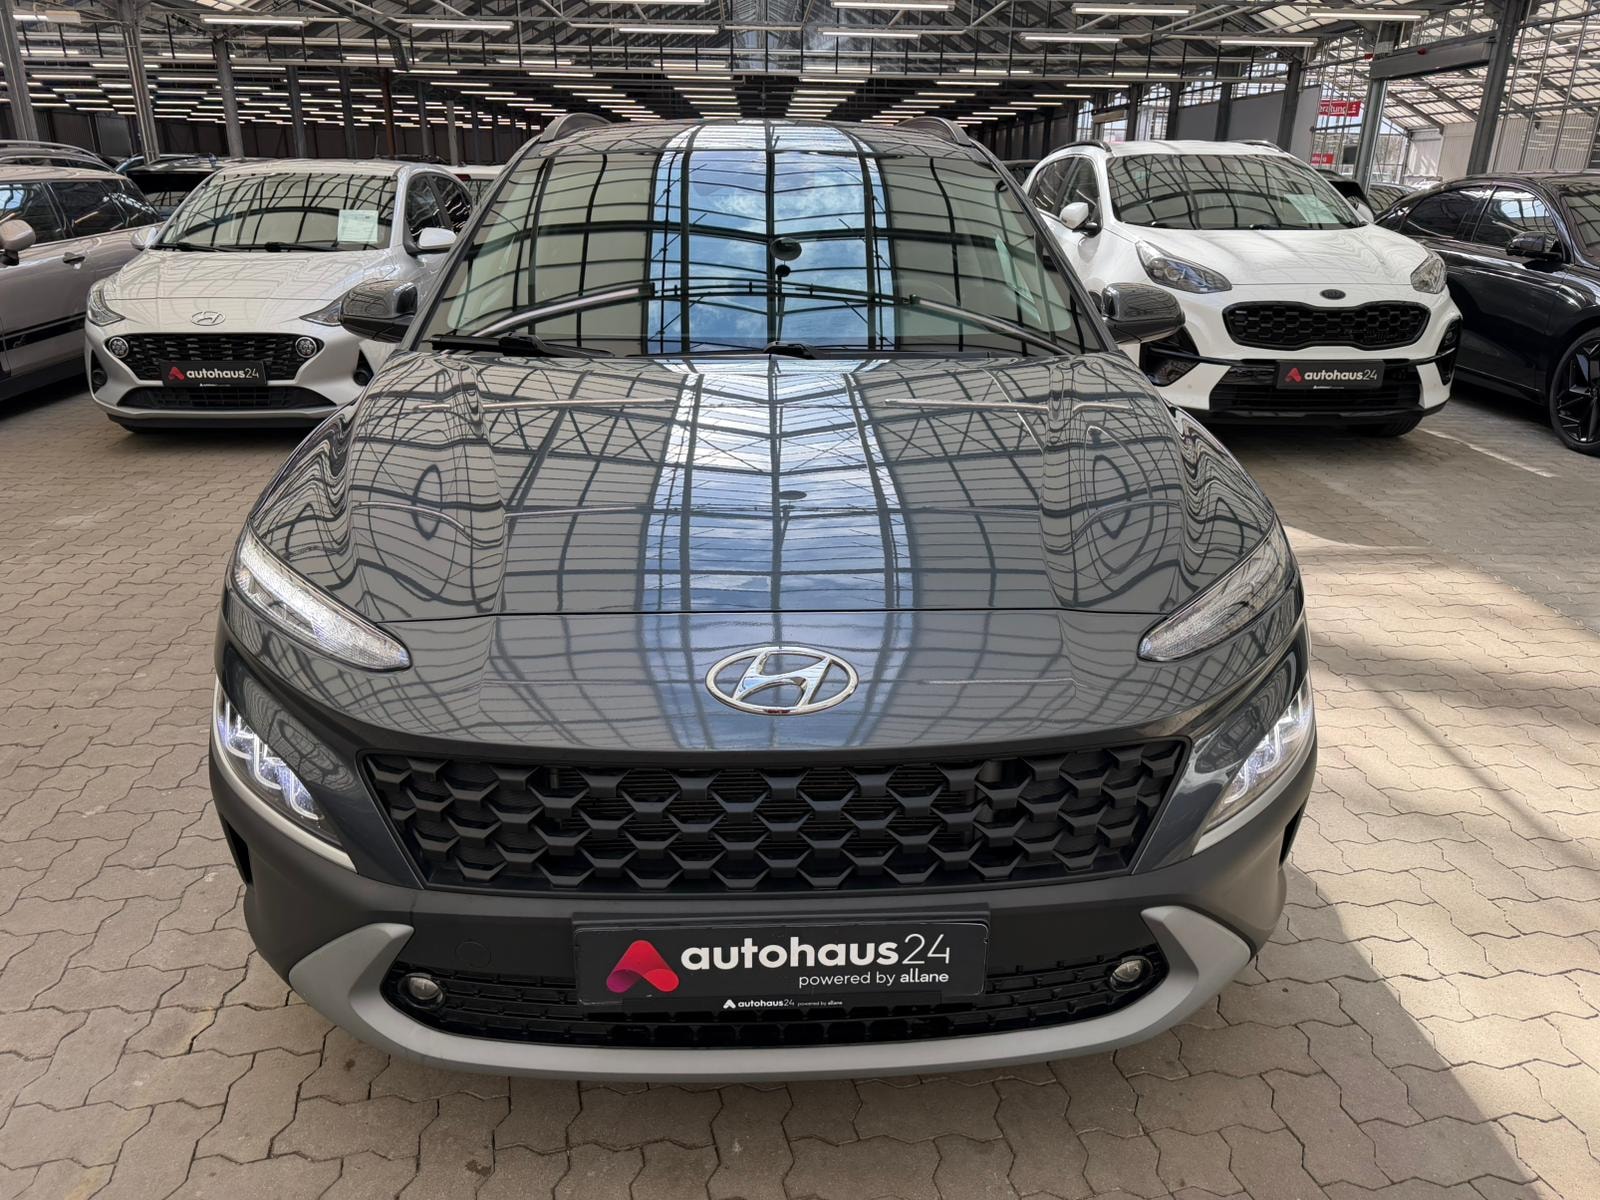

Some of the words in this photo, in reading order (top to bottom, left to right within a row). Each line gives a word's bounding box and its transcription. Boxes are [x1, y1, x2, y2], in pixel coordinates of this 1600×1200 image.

[186, 367, 259, 378] autohaus24
[1304, 369, 1377, 380] autohaus24
[681, 933, 950, 970] autohaus24
[799, 971, 870, 988] powered
[876, 971, 896, 986] by
[900, 968, 949, 983] allane
[738, 999, 795, 1007] autohaus24
